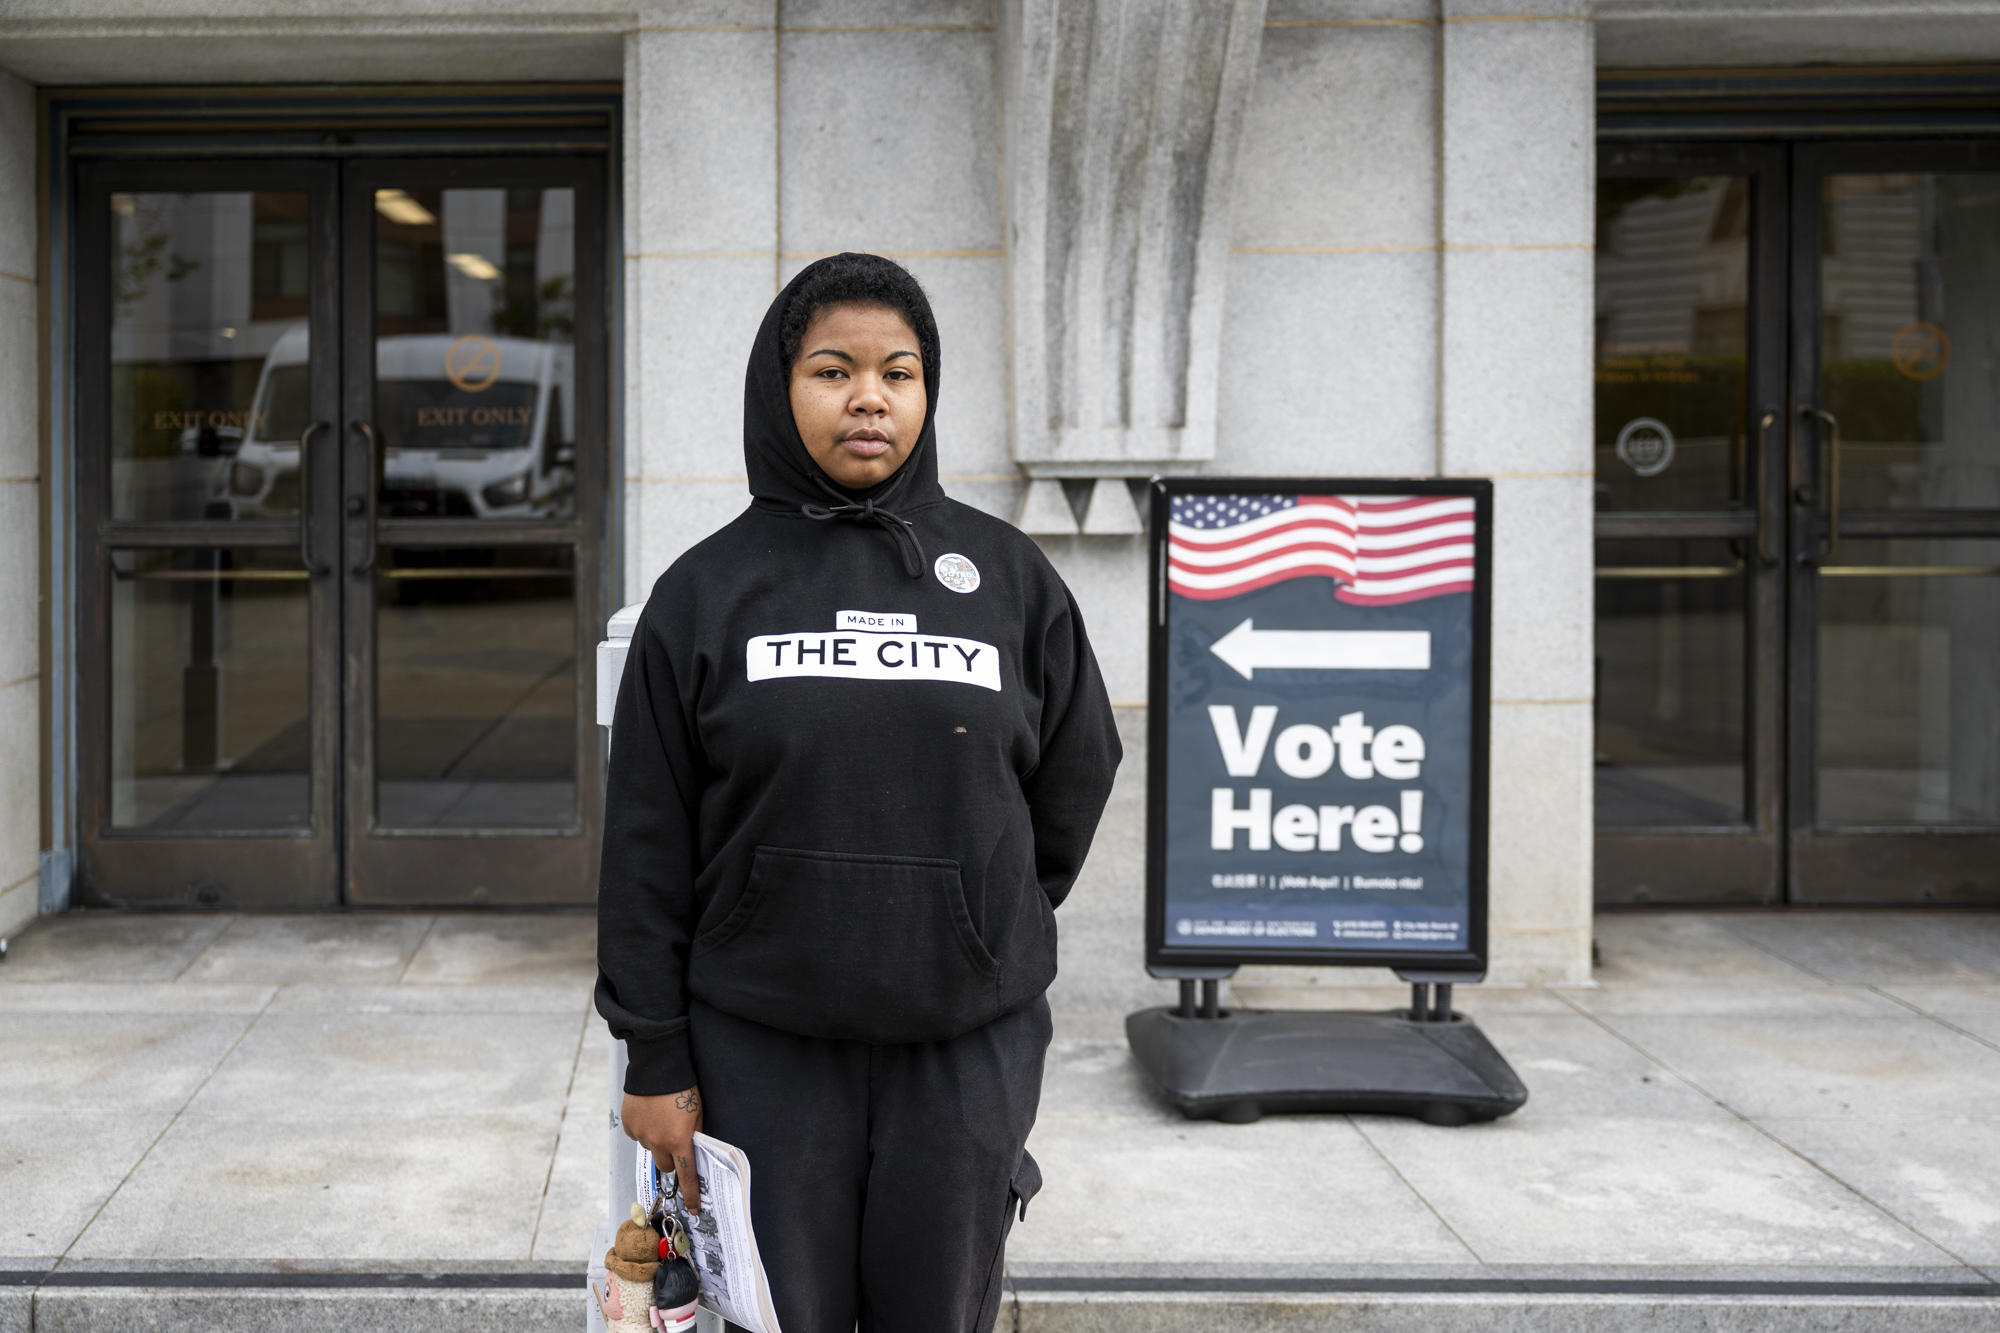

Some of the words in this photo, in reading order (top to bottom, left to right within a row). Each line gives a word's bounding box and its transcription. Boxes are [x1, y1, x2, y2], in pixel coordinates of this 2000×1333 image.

[154, 411, 205, 429] EXIT
[418, 407, 468, 426] EXIT
[472, 406, 532, 426] ONLY
[847, 615, 885, 627] MADE
[891, 617, 905, 627] IN
[766, 638, 857, 667] THE
[876, 640, 982, 673] CITY
[1207, 704, 1426, 780] Vote
[1210, 787, 1425, 854] Here!
